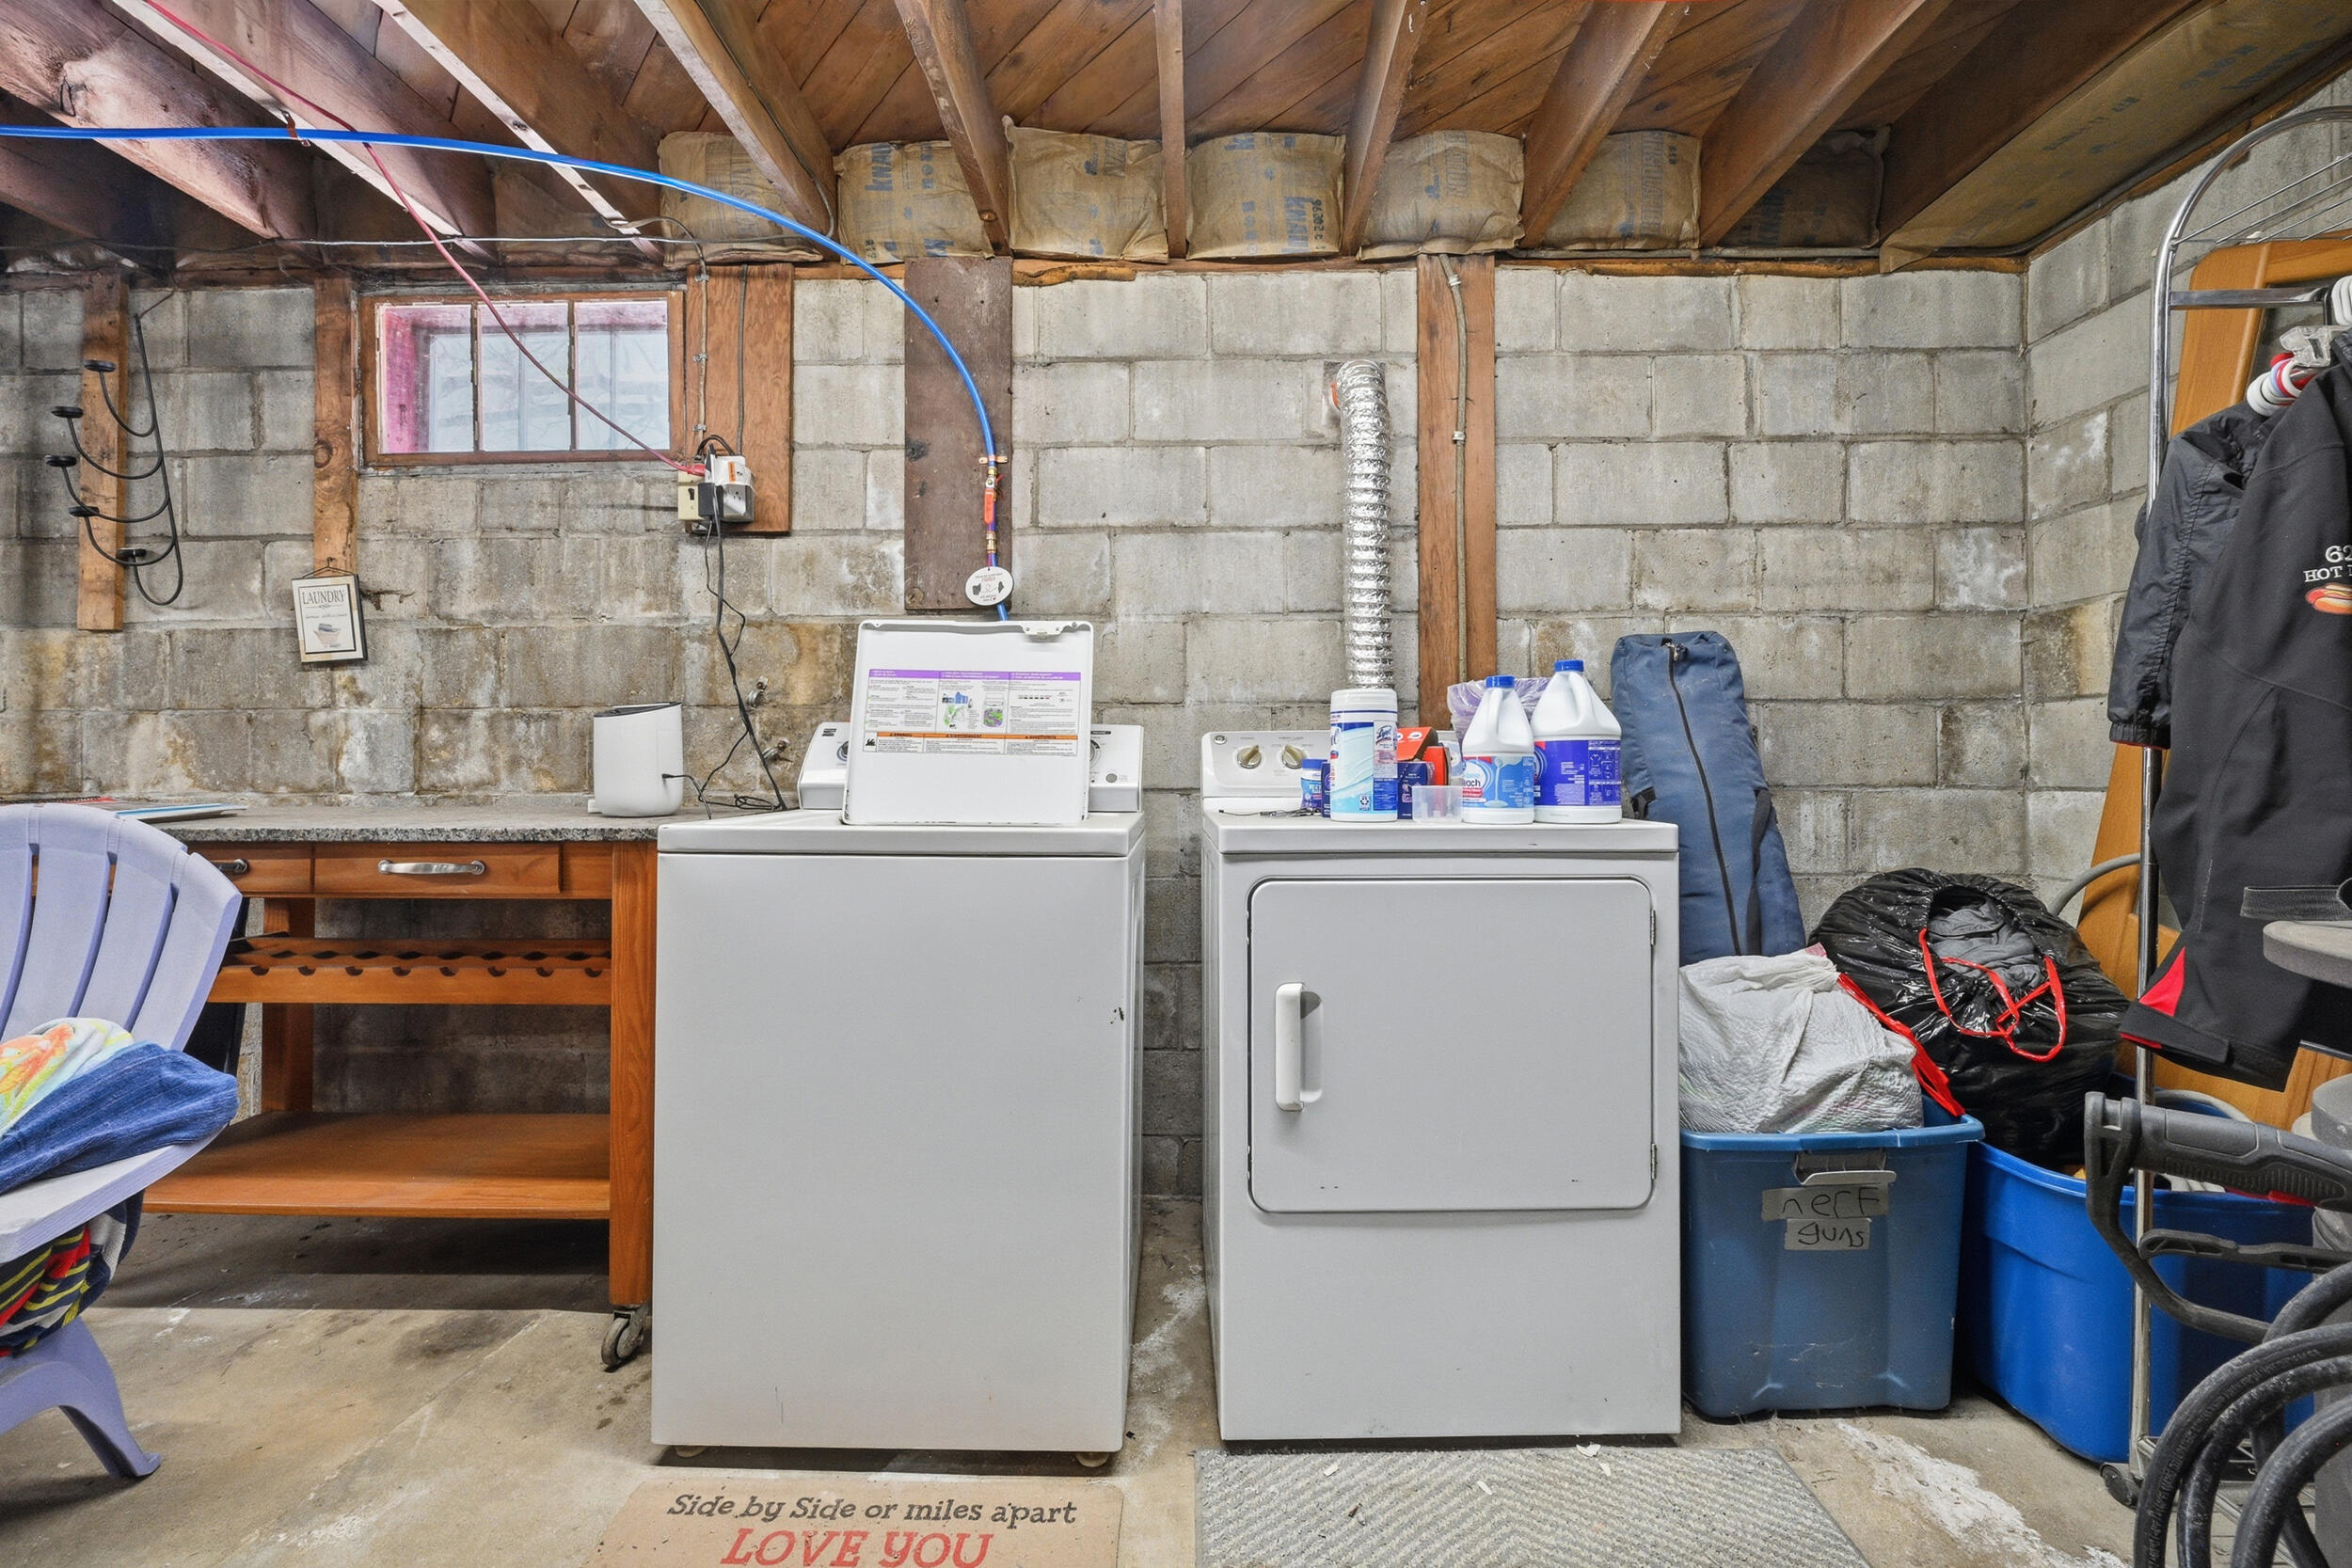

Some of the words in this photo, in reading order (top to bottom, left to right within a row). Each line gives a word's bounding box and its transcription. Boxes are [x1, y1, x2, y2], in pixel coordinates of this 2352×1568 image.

[2303, 566, 2343, 582] HOT
[302, 590, 345, 604] LAUNDRY
[1797, 1221, 1866, 1248] guns
[667, 1495, 734, 1515] Side
[739, 1496, 787, 1523] by
[789, 1497, 856, 1521] Side
[864, 1503, 899, 1520] or
[903, 1499, 984, 1522] miles
[991, 1502, 1078, 1529] apart
[720, 1528, 867, 1567] LOVE
[881, 1530, 994, 1568] YOU
